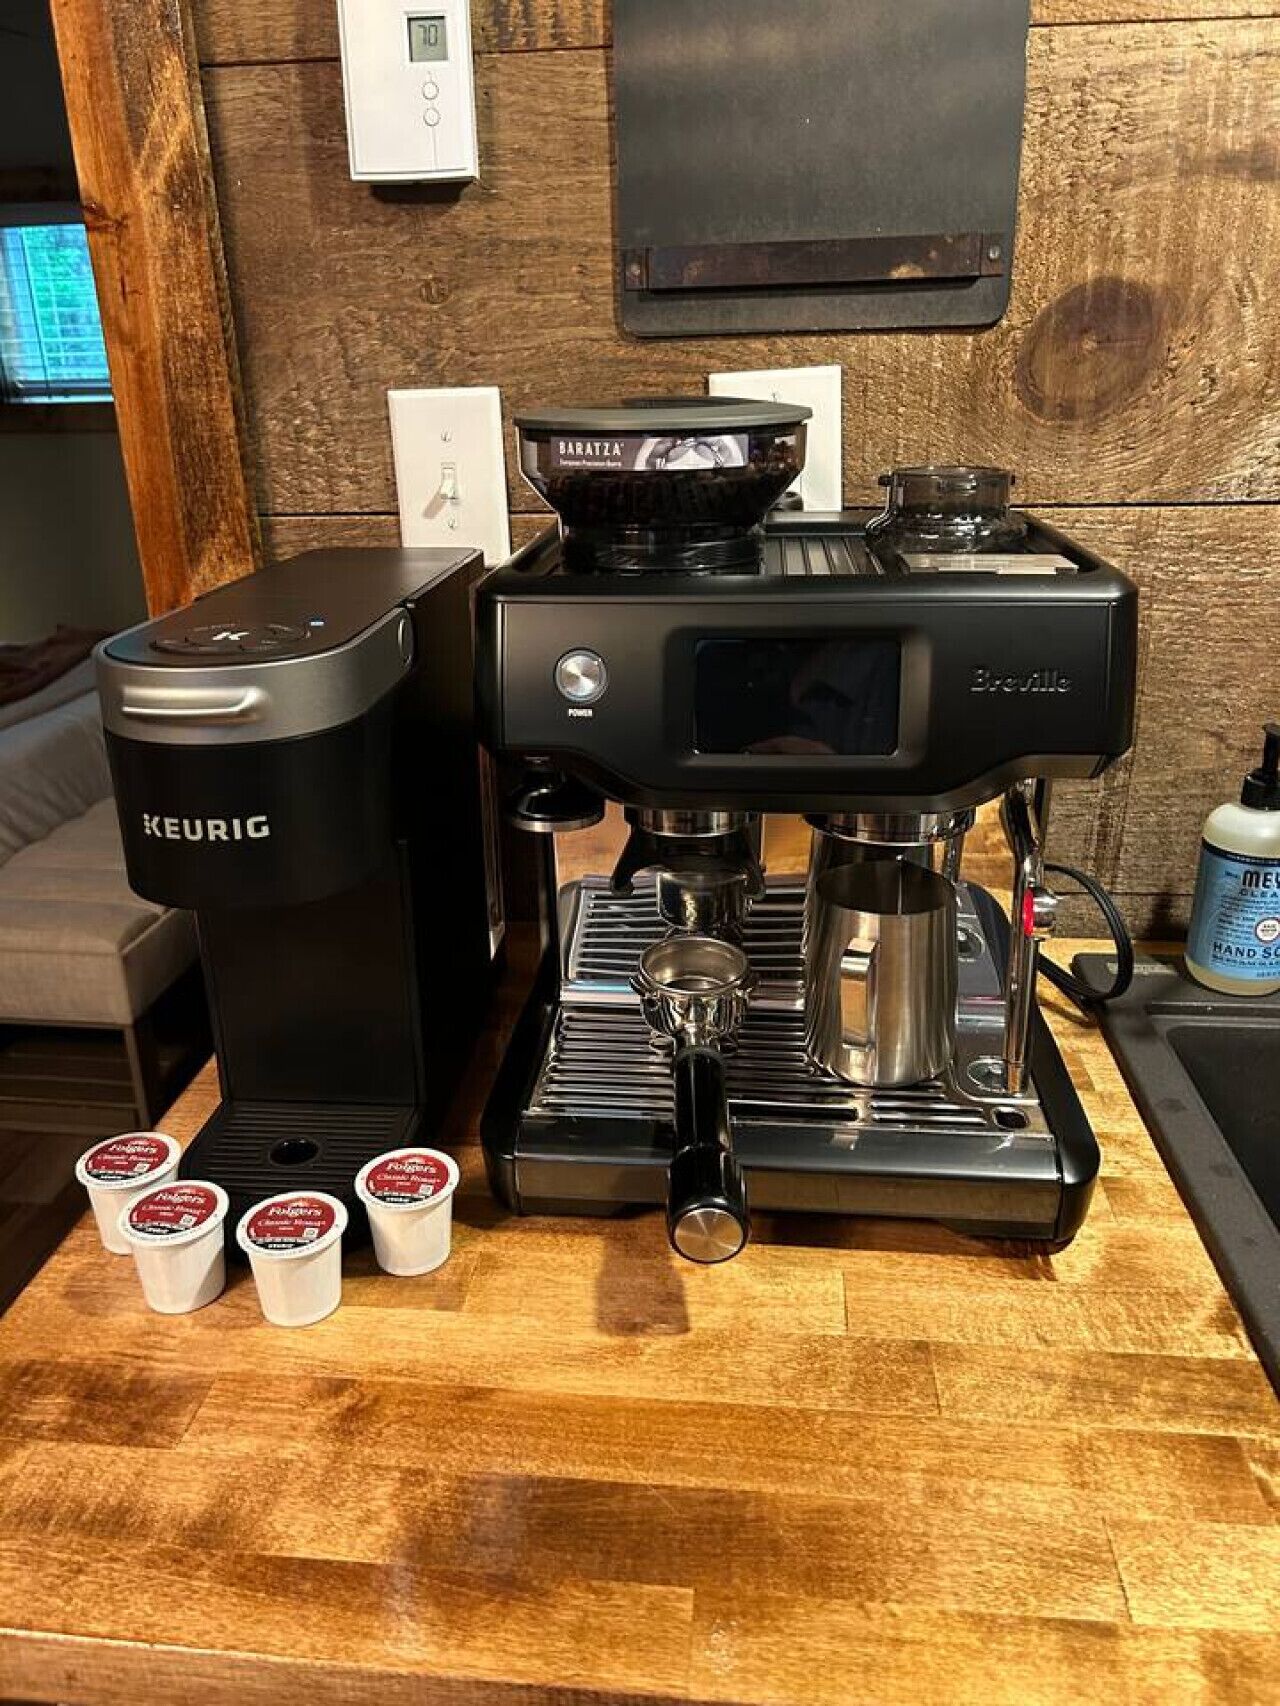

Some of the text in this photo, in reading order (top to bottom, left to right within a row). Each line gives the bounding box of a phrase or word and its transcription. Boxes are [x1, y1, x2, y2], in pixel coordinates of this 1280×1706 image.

[417, 24, 438, 46] 70
[559, 441, 621, 456] BARATZA
[970, 668, 1072, 693] Breville
[568, 708, 593, 717] POWER
[143, 813, 270, 841] KEURIG
[1213, 941, 1256, 958] HAND
[387, 1162, 437, 1174] Folgers
[153, 1191, 206, 1204] Folgers
[267, 1206, 323, 1218] Folgers
